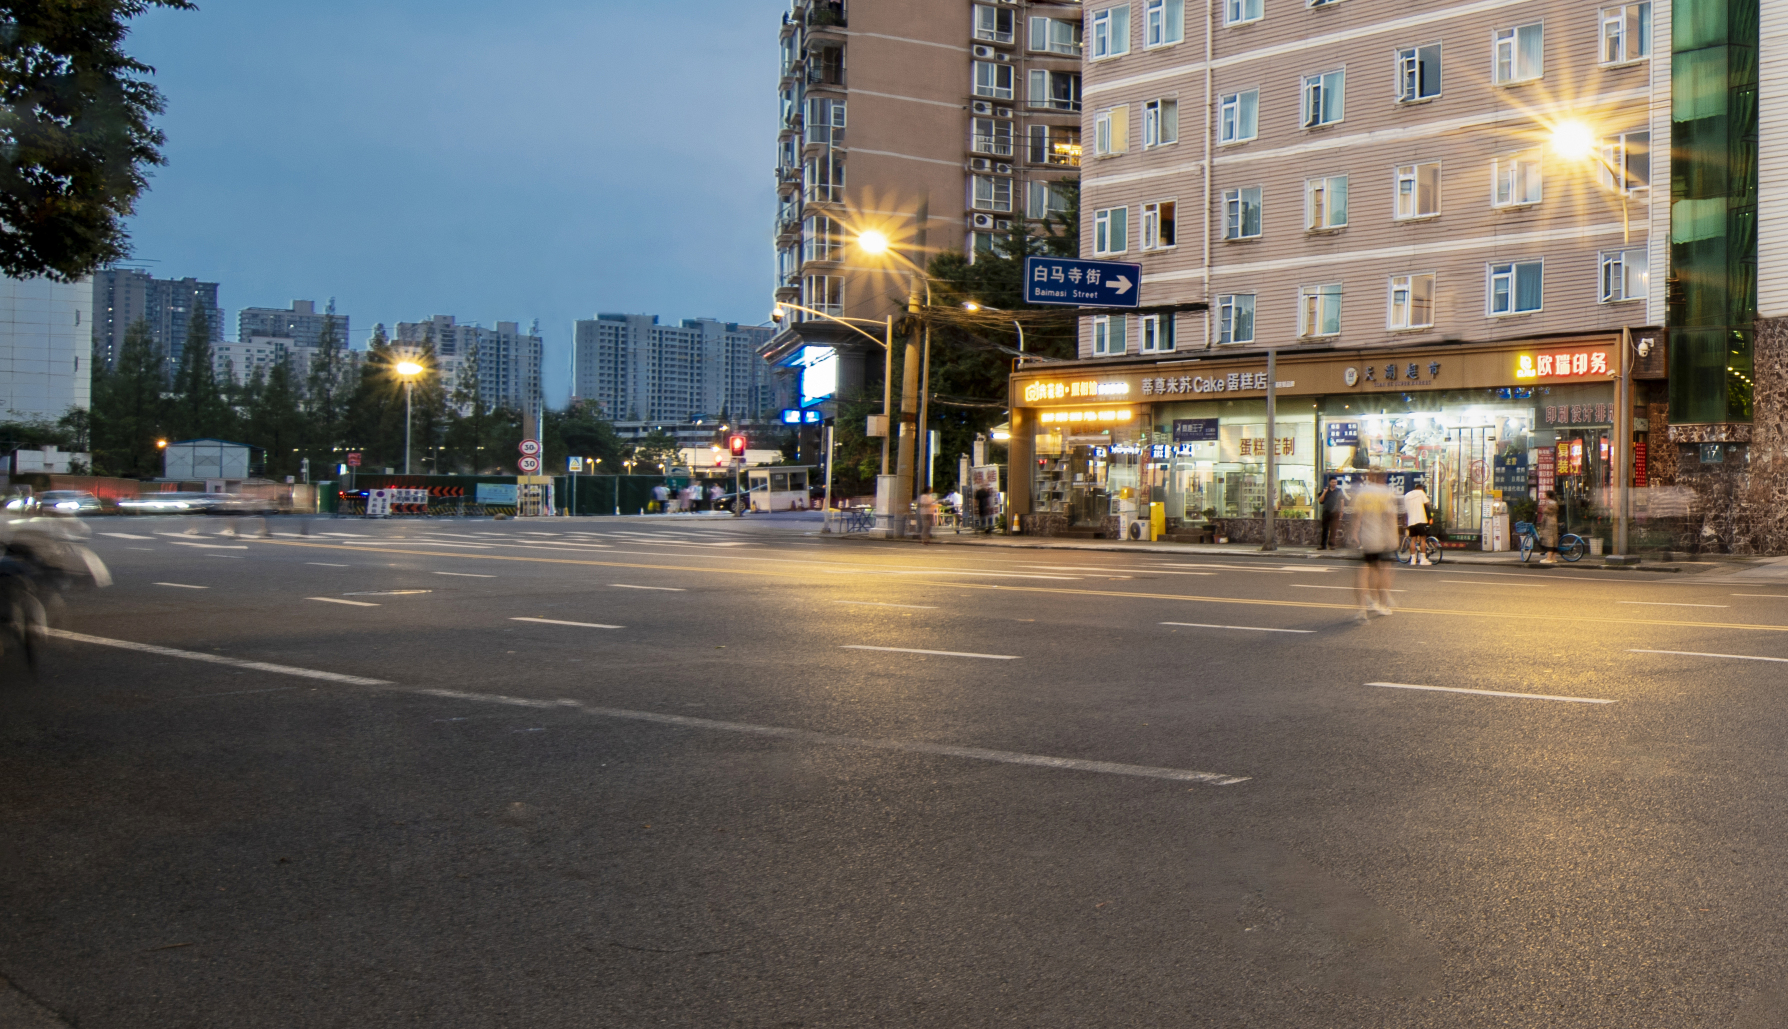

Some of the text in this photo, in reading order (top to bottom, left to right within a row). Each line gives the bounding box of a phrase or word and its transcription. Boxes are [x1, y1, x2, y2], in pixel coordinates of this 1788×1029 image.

[1034, 265, 1101, 285] 白马寺街
[1035, 287, 1098, 299] Baimasi Street
[1364, 361, 1441, 381] 天湖超市
[1537, 352, 1606, 376] 欧瑞印务
[524, 460, 535, 468] 30
